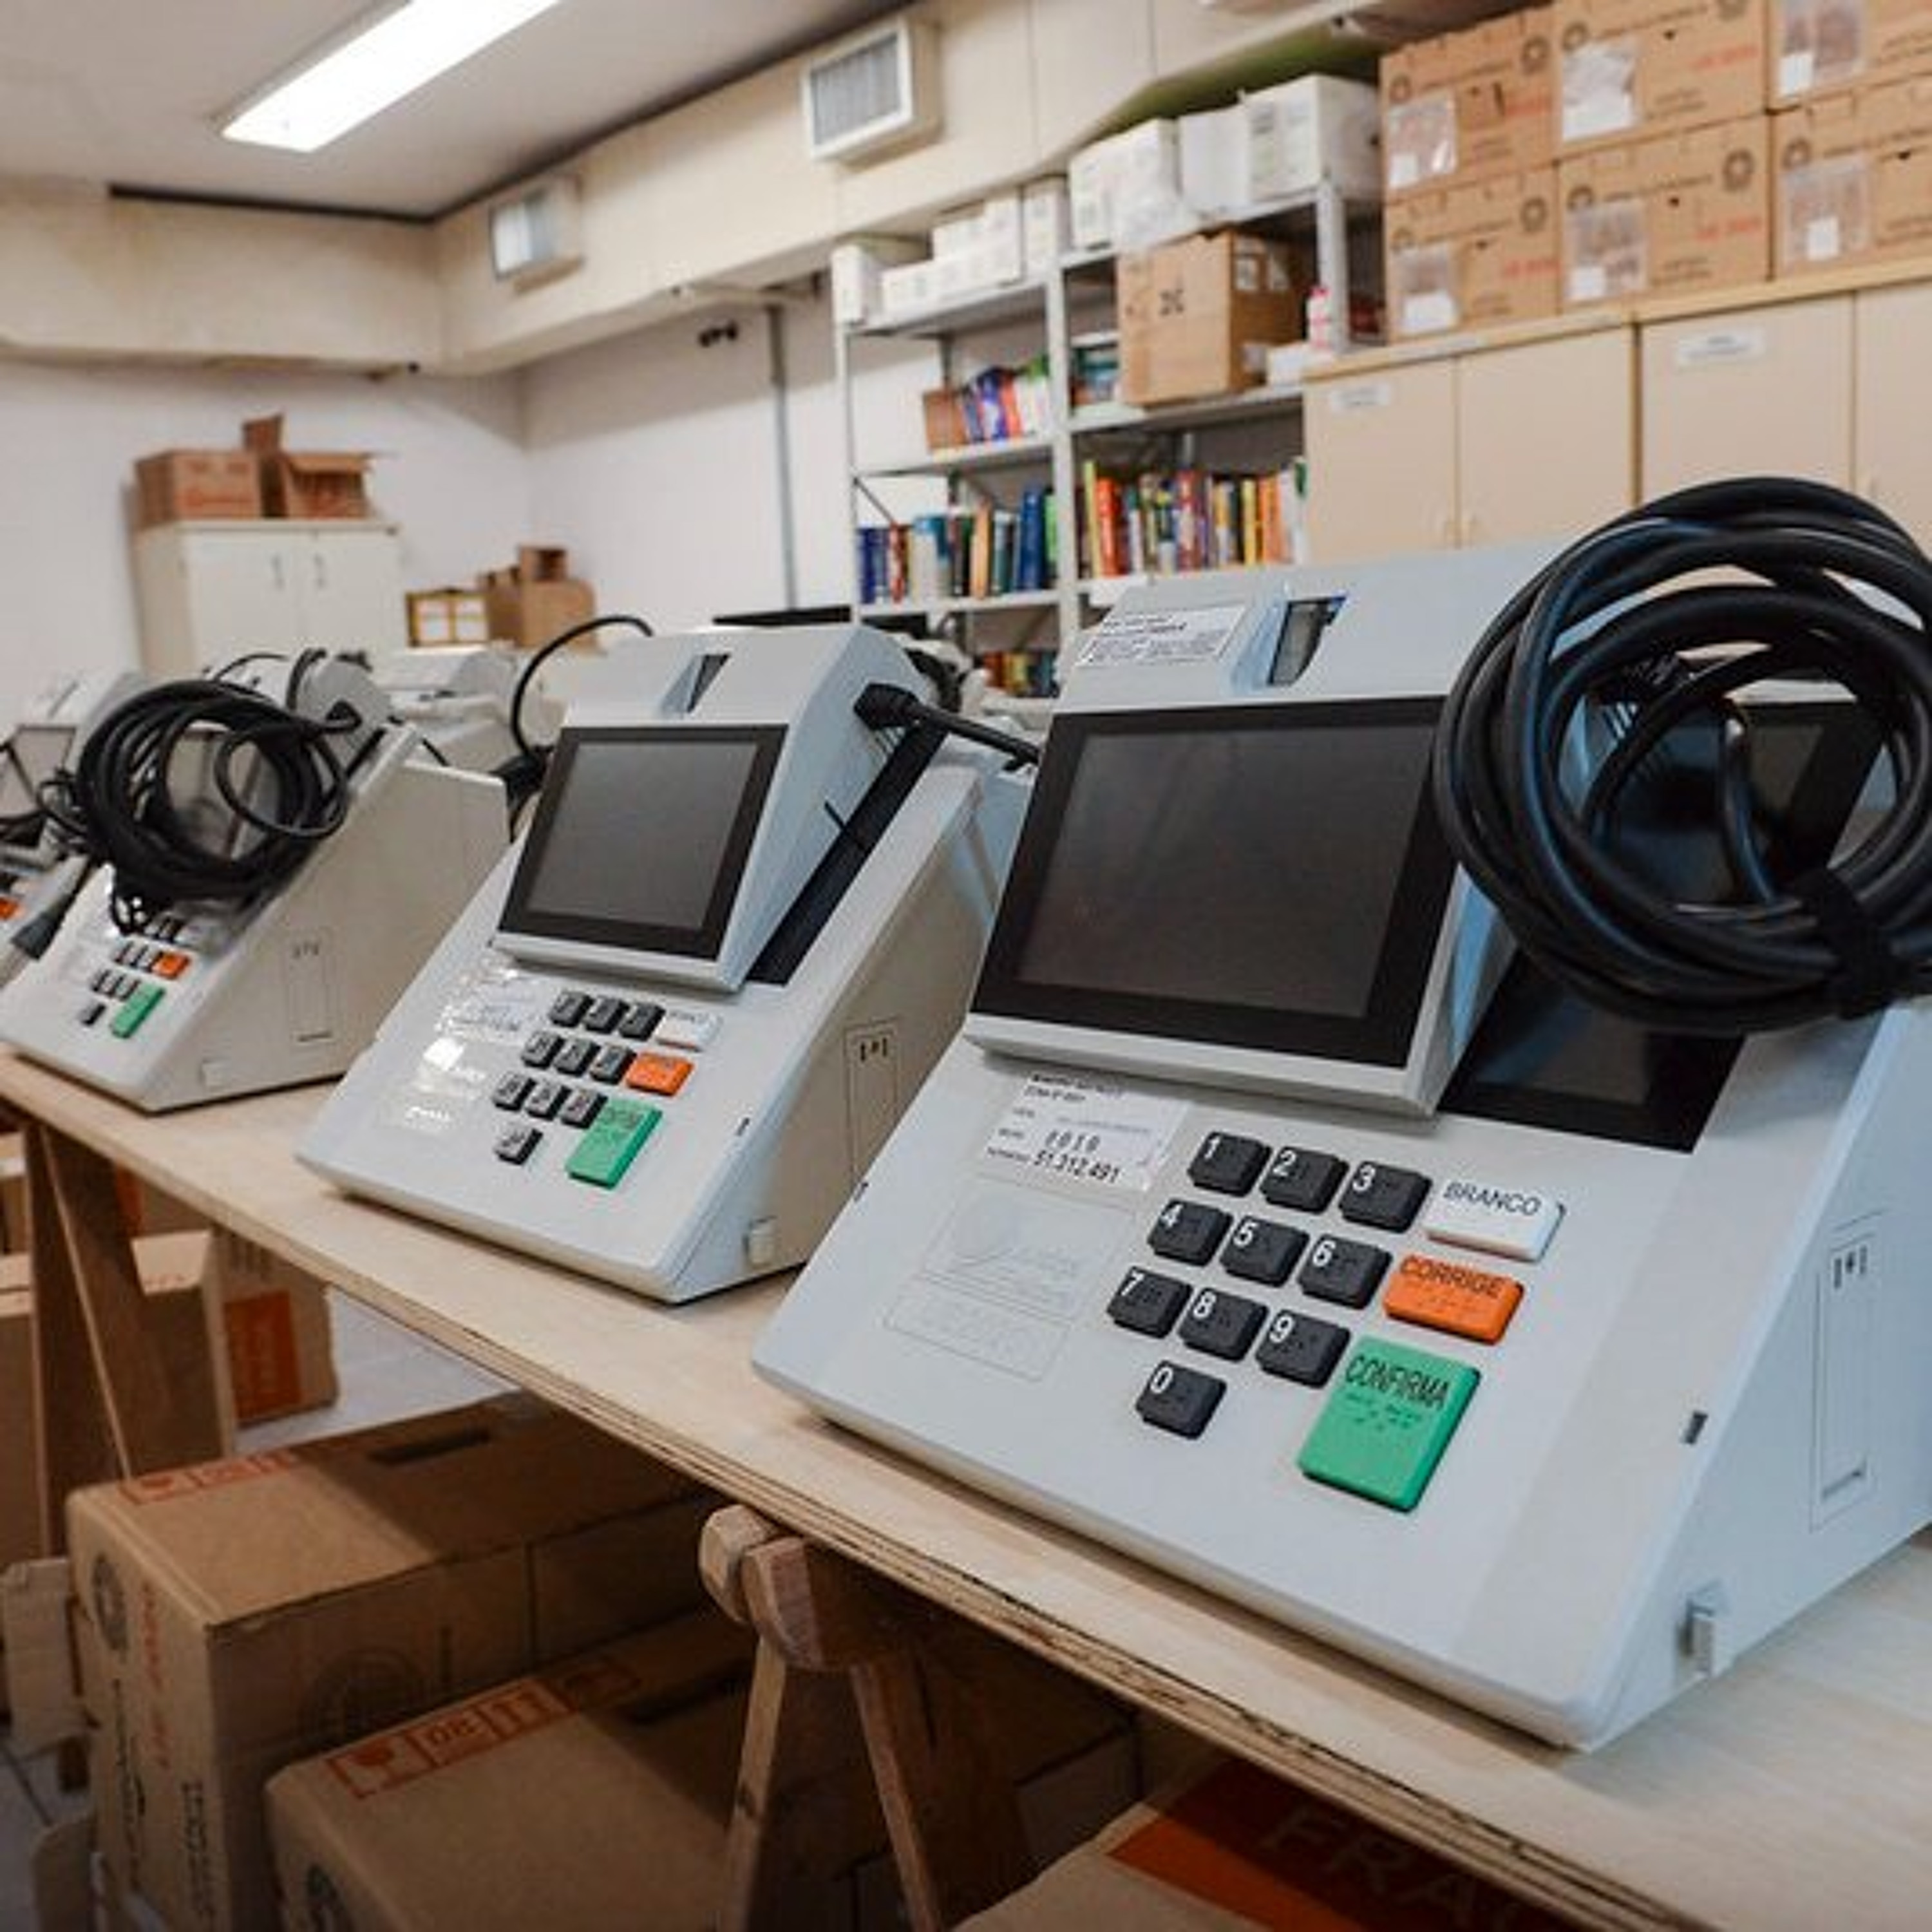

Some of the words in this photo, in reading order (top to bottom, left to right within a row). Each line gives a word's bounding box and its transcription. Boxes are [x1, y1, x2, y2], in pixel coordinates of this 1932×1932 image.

[1204, 1136, 1220, 1159] 1
[1273, 1150, 1296, 1176] 2
[1353, 1165, 1376, 1191] 3
[1443, 1181, 1542, 1217] BRANCO
[1161, 1204, 1184, 1227] 4
[1233, 1221, 1258, 1247] 5
[1312, 1240, 1336, 1267] 6
[1400, 1256, 1504, 1297] CORRIGE
[1121, 1271, 1144, 1296] 7
[1193, 1291, 1217, 1319] 8
[1269, 1315, 1294, 1343] 9
[1150, 1367, 1173, 1394] 0
[1345, 1355, 1449, 1409] CONFIRMA
